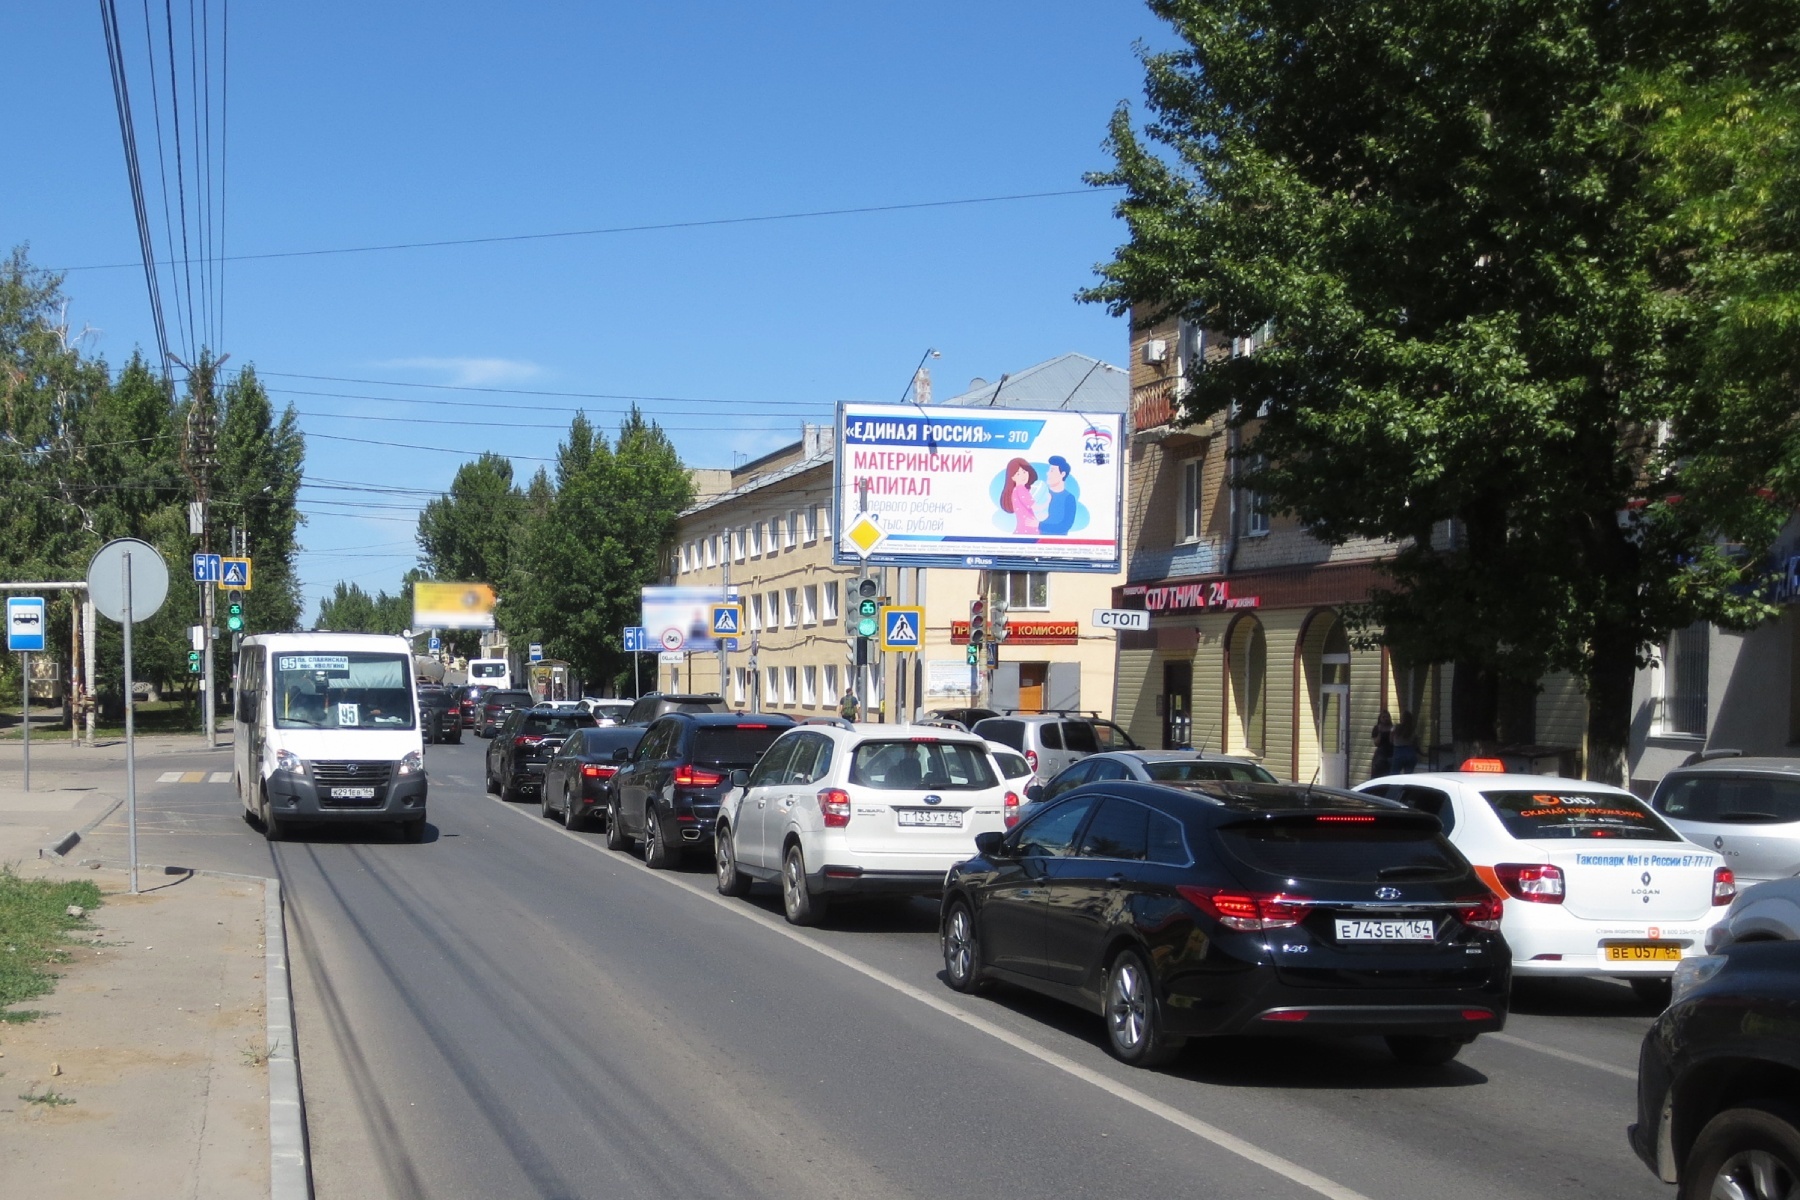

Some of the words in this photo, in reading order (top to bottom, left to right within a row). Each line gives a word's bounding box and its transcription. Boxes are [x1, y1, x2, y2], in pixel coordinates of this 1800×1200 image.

[846, 421, 917, 442] «ЕДИНАЯ
[922, 424, 992, 443] РОССИЯ»
[1008, 431, 1029, 443] ЭТО
[853, 450, 974, 473] МАТЕРИНСКИЙ
[867, 499, 908, 514] первого
[910, 498, 953, 514] ребенка
[883, 518, 903, 530] тыс.
[906, 517, 944, 532] рублей
[974, 557, 993, 565] Russ
[1145, 584, 1204, 610] СПУТНИК
[1209, 582, 1226, 606] 24
[231, 605, 240, 614] 26
[862, 603, 874, 614] 26
[1101, 612, 1140, 626] СТОП
[1018, 626, 1078, 635] КОМИССИЯ
[281, 658, 296, 669] 95
[341, 705, 356, 724] 95
[1560, 796, 1596, 805] DiDi
[947, 811, 959, 821] 64
[1520, 807, 1567, 817] СКАЧАЙ
[1576, 853, 1625, 867] Таксопарк
[1627, 855, 1642, 867] №1
[1643, 857, 1649, 866] в
[1651, 855, 1681, 867] России
[1683, 856, 1713, 867] 57-77-77
[1342, 921, 1404, 938] Е743ЕК
[1406, 920, 1430, 935] 164
[1634, 945, 1658, 959] 057
